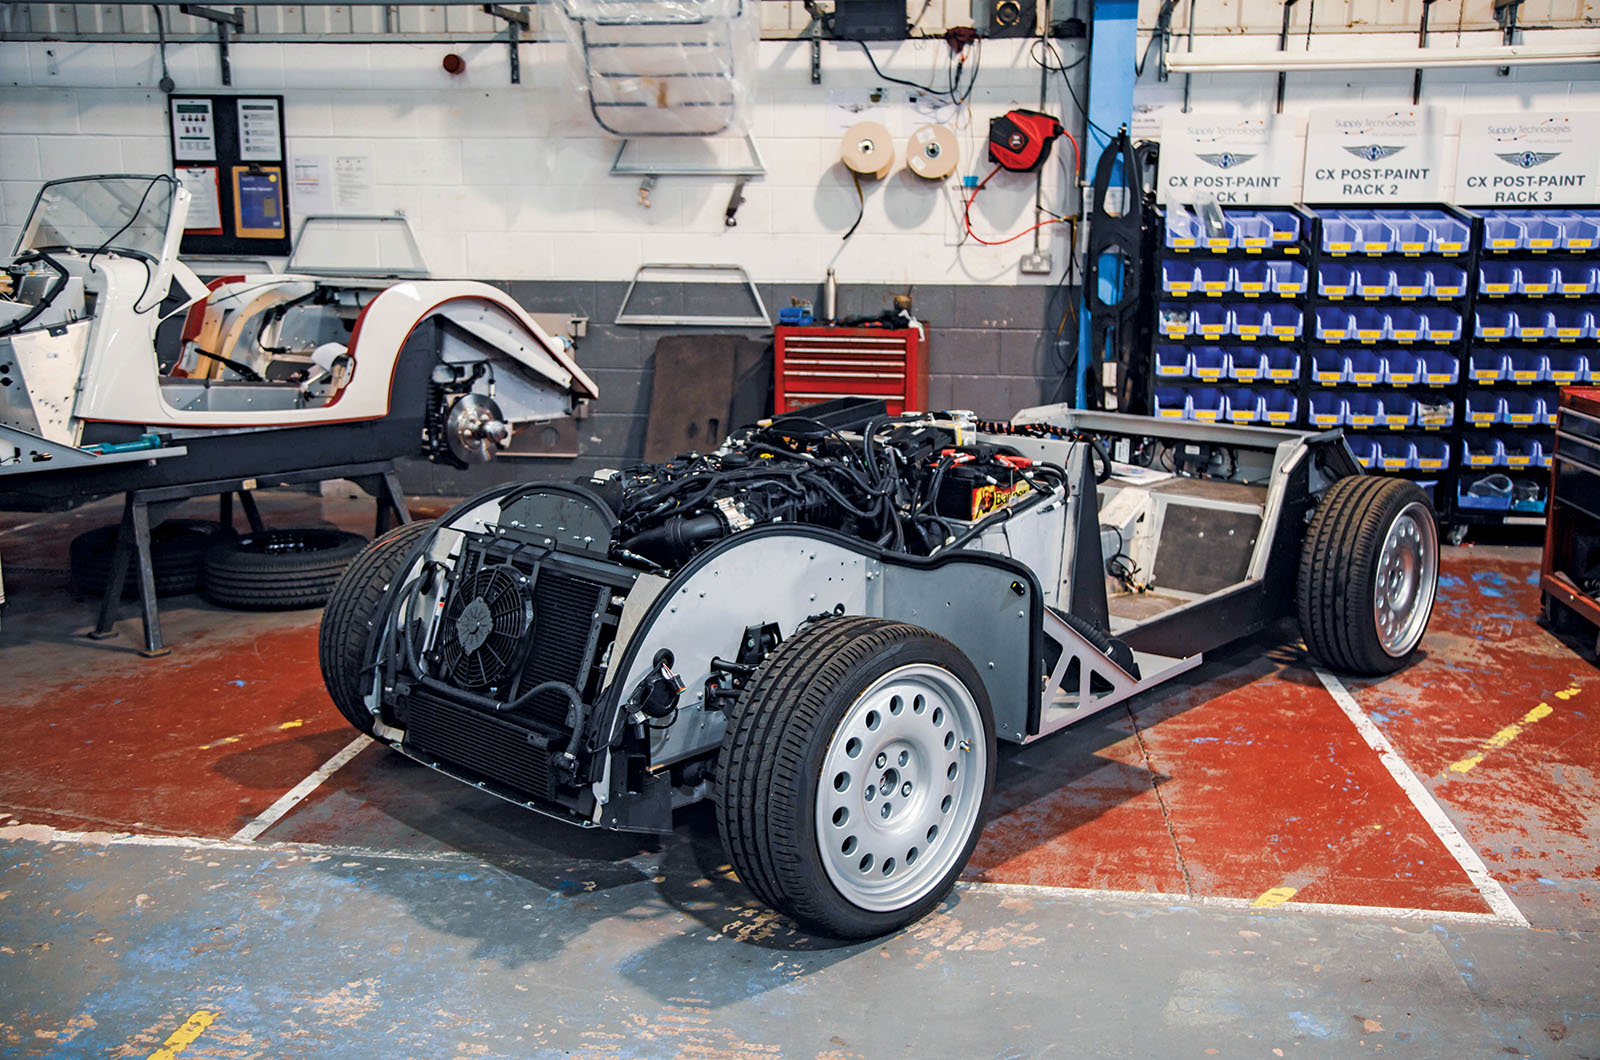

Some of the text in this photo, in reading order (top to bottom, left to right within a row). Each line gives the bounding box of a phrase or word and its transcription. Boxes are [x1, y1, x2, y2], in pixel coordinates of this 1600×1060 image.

[1315, 168, 1430, 180] CX POST-PAINT
[1169, 176, 1281, 188] CX POST-PAINT
[1467, 175, 1586, 187] CX POST-PAINT
[1343, 184, 1398, 195] RACK 2
[1244, 192, 1249, 202] 1
[1495, 191, 1553, 202] RACK 3
